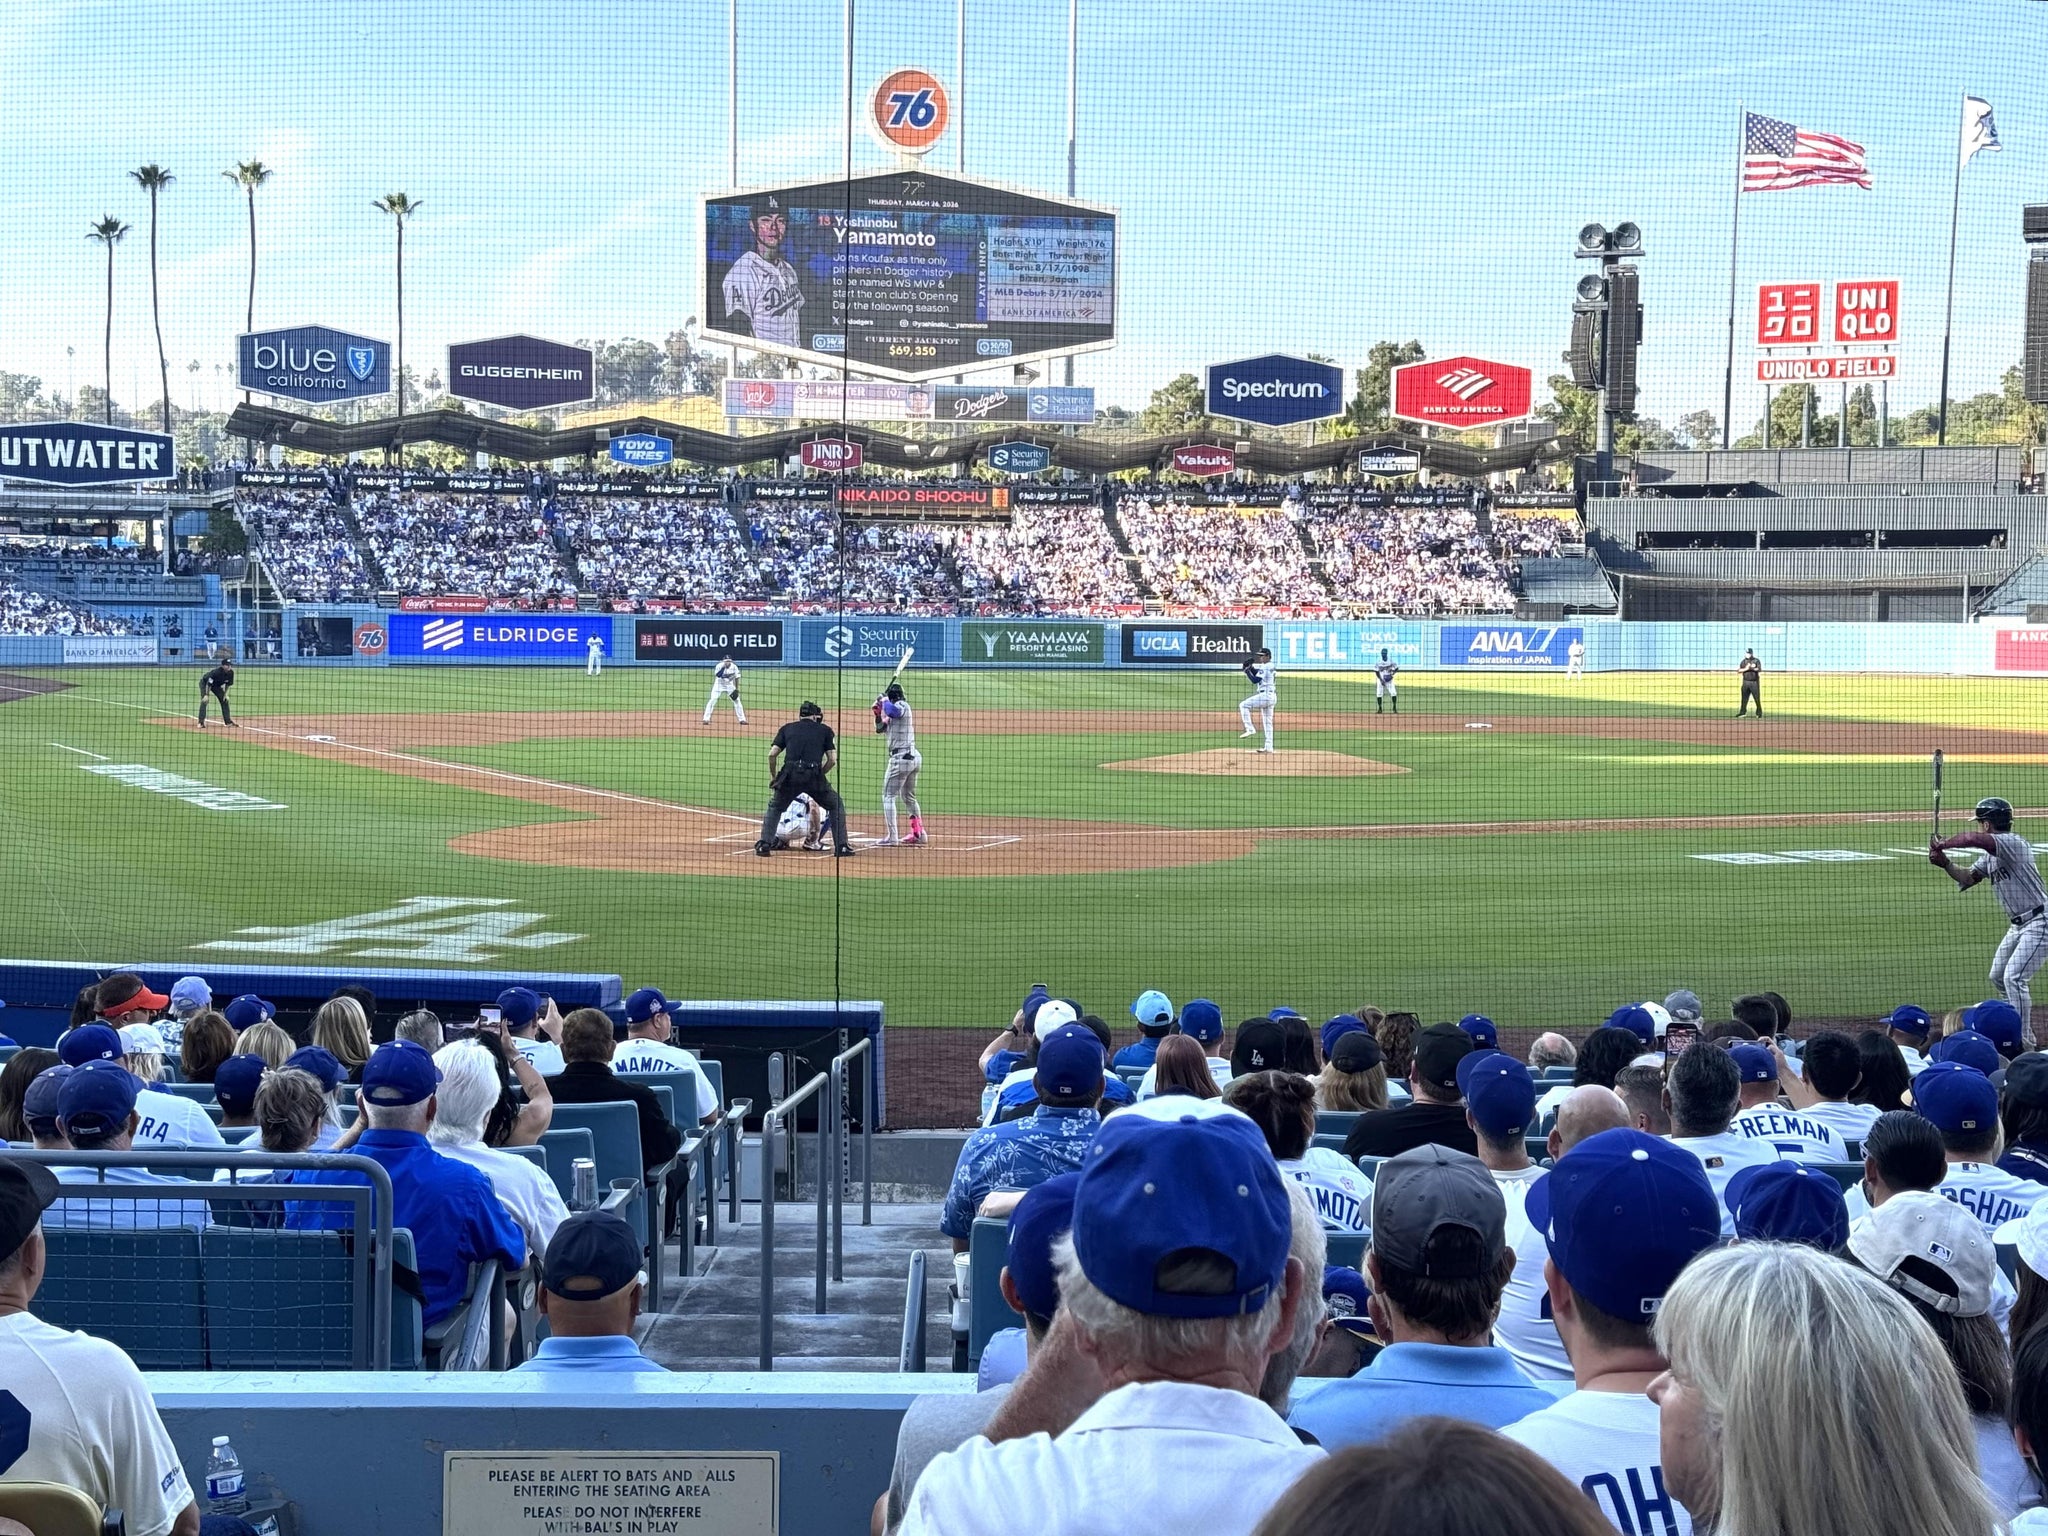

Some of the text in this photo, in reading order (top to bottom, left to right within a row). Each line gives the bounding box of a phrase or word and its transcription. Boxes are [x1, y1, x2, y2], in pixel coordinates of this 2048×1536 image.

[886, 88, 938, 129] 76
[868, 198, 904, 207] THURSDAY,
[833, 228, 936, 246] Yamamoto
[1090, 240, 1105, 248] 176
[833, 253, 859, 265] Jons
[862, 254, 895, 264] Koufax
[910, 256, 925, 265] the
[927, 256, 947, 266] only
[1015, 251, 1037, 259] Right
[874, 267, 882, 275] in
[884, 266, 919, 277] Dodger
[921, 268, 953, 279] history
[860, 278, 892, 287] named
[895, 279, 911, 288] WS
[914, 279, 935, 288] MVP
[938, 280, 945, 289] &
[1050, 276, 1079, 285] Japan
[857, 290, 872, 298] the
[890, 290, 917, 300] club's
[1842, 288, 1888, 310] UNI
[854, 302, 869, 310] the
[871, 302, 913, 313] following
[1841, 312, 1891, 338] QLO
[865, 335, 961, 345] CURRENT JACKPOT
[254, 338, 336, 372] blue
[889, 344, 936, 357] $69,350
[461, 365, 583, 381] GUGGENHEIM
[1763, 358, 1891, 379] UNIQLO FIELD
[267, 374, 346, 389] california
[1222, 377, 1324, 402] Spectrum
[954, 388, 1008, 418] Dodgers
[1461, 406, 1504, 414] AMERICA
[618, 441, 656, 450] TOYO
[1, 437, 159, 470] UTWATER
[624, 450, 665, 460] TIRES
[811, 444, 853, 463] JINRO
[1011, 450, 1044, 458] Security
[1176, 455, 1231, 466] Yakult
[838, 489, 911, 502] NIKAIDO
[915, 490, 987, 503] SHOCHU
[359, 630, 384, 649] 76
[473, 627, 579, 642] ELDRIDGE
[859, 626, 919, 644] Security
[2011, 631, 2048, 642] BANK
[674, 633, 728, 650] UNIQLO
[733, 634, 777, 648] FIELD
[1141, 636, 1251, 653] UCLA Health
[1282, 632, 1347, 659] TEL
[1468, 631, 1524, 652] ANA
[1468, 656, 1552, 664] Inspiration of JAPAN
[1251, 1049, 1264, 1066] LA
[615, 1056, 684, 1073] MAMOT
[488, 1470, 735, 1482] PLEASE BE ALERT TO BATS AND ALLS
[513, 1485, 710, 1497] ENTERING THE SEATING AREA
[575, 1506, 595, 1518] DO
[600, 1506, 629, 1518] NOT
[634, 1506, 701, 1518] INTERFERE
[545, 1522, 580, 1533] WITH
[628, 1522, 642, 1533] IN
[647, 1522, 678, 1533] PLAY
